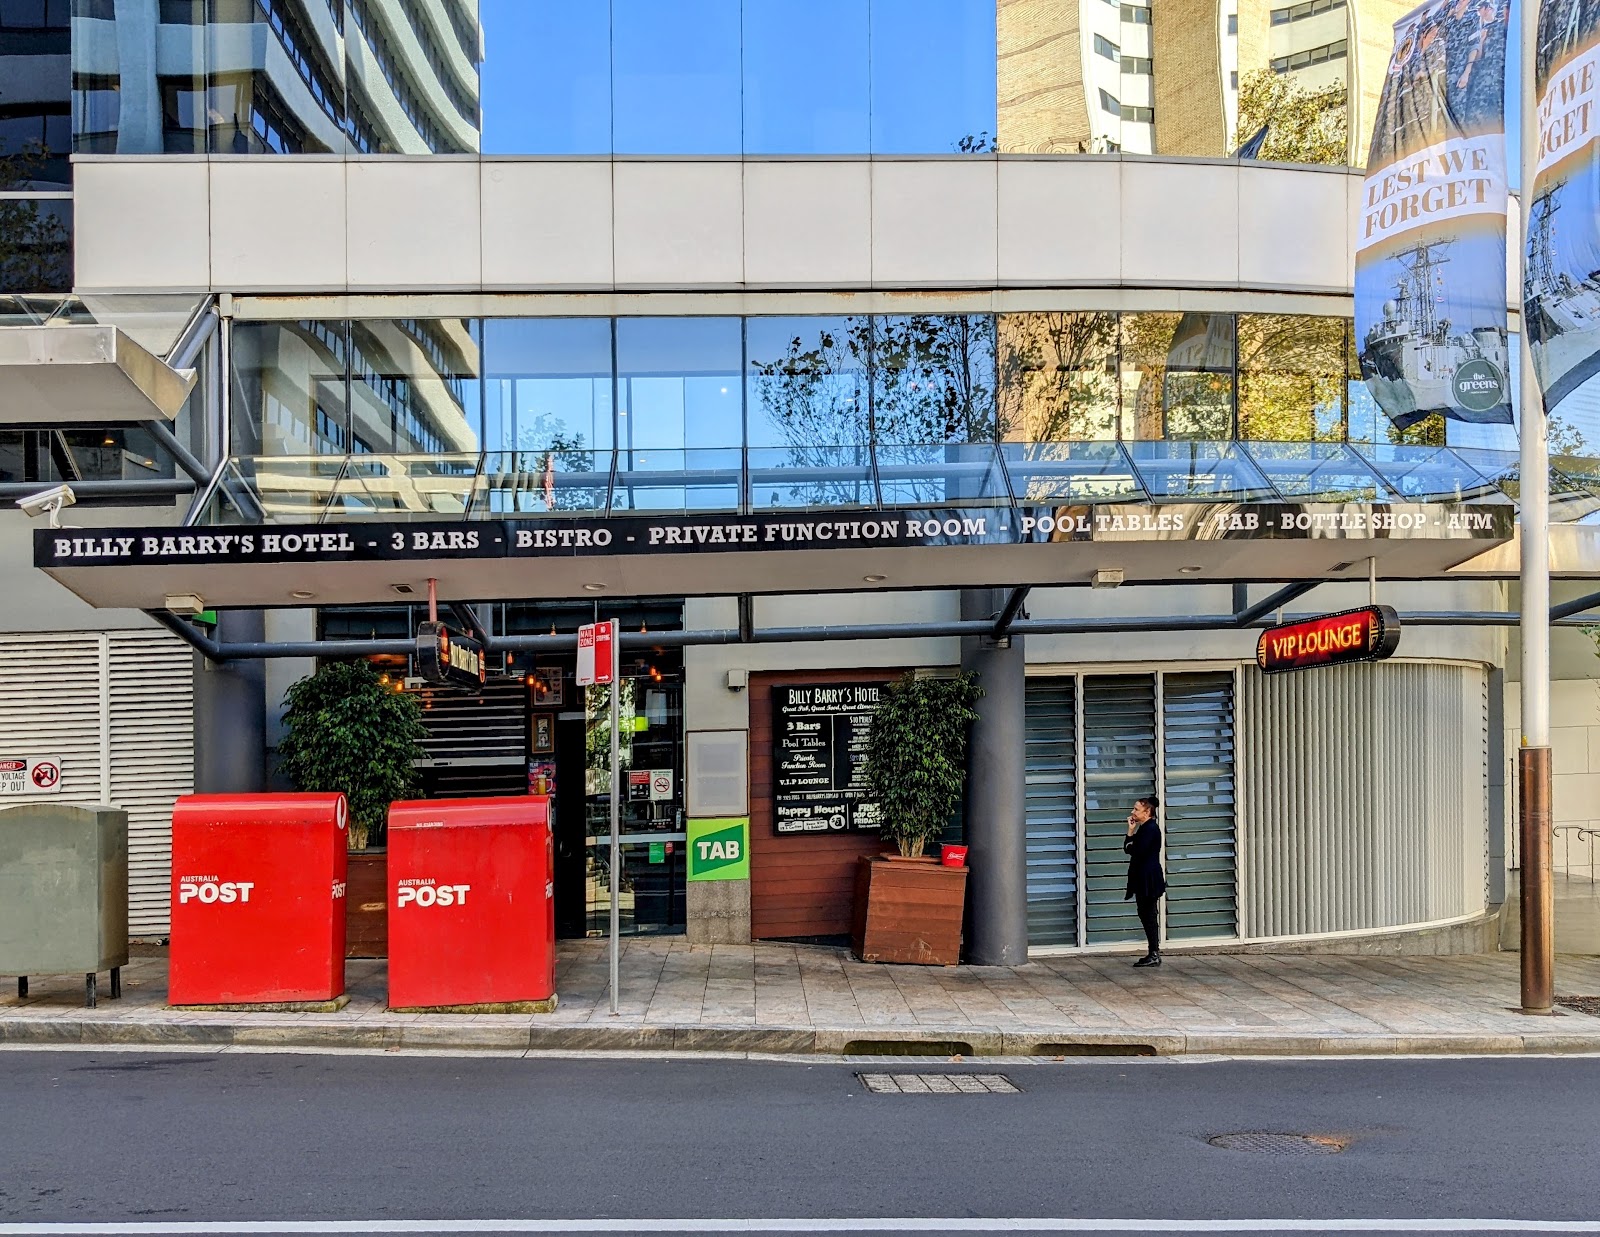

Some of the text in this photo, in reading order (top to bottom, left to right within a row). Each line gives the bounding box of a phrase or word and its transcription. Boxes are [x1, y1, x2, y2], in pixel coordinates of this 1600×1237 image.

[1560, 61, 1595, 106] WE
[1367, 147, 1489, 209] LEST WE
[1363, 178, 1492, 240] FORGET
[1459, 380, 1499, 393] greens
[54, 537, 134, 557] BILLY
[142, 535, 255, 555] BARRY'S
[262, 533, 355, 553] HOTEL
[391, 533, 404, 550] 3
[412, 531, 480, 550] BARS
[516, 528, 612, 548] BISTRO
[648, 524, 758, 545] PRIVATE
[764, 520, 900, 542] FUNCTION
[905, 518, 987, 538] ROOM
[1021, 516, 1091, 534] POOL
[1096, 514, 1184, 532] TABLES
[1215, 513, 1259, 531] TAB
[1280, 513, 1366, 530] BOTTLE
[1371, 513, 1427, 530] SHOP
[1446, 513, 1493, 530] ATM
[580, 629, 594, 639] MAIL
[580, 638, 594, 647] ZONE
[1273, 623, 1362, 659] VIP LOUNGE
[788, 686, 880, 705] BILLY BARRY'S HOTEL
[787, 722, 821, 731] 3 Bars
[782, 738, 826, 748] Pool Tables
[793, 754, 815, 762] Private
[0, 762, 16, 770] ANGER
[781, 760, 826, 770] Function Room
[1, 772, 26, 781] VOLTAGE
[10, 781, 25, 791] OUT
[778, 804, 845, 818] Happy Hour!
[697, 840, 740, 860] TAB
[180, 882, 254, 904] POST
[397, 885, 470, 907] POST
